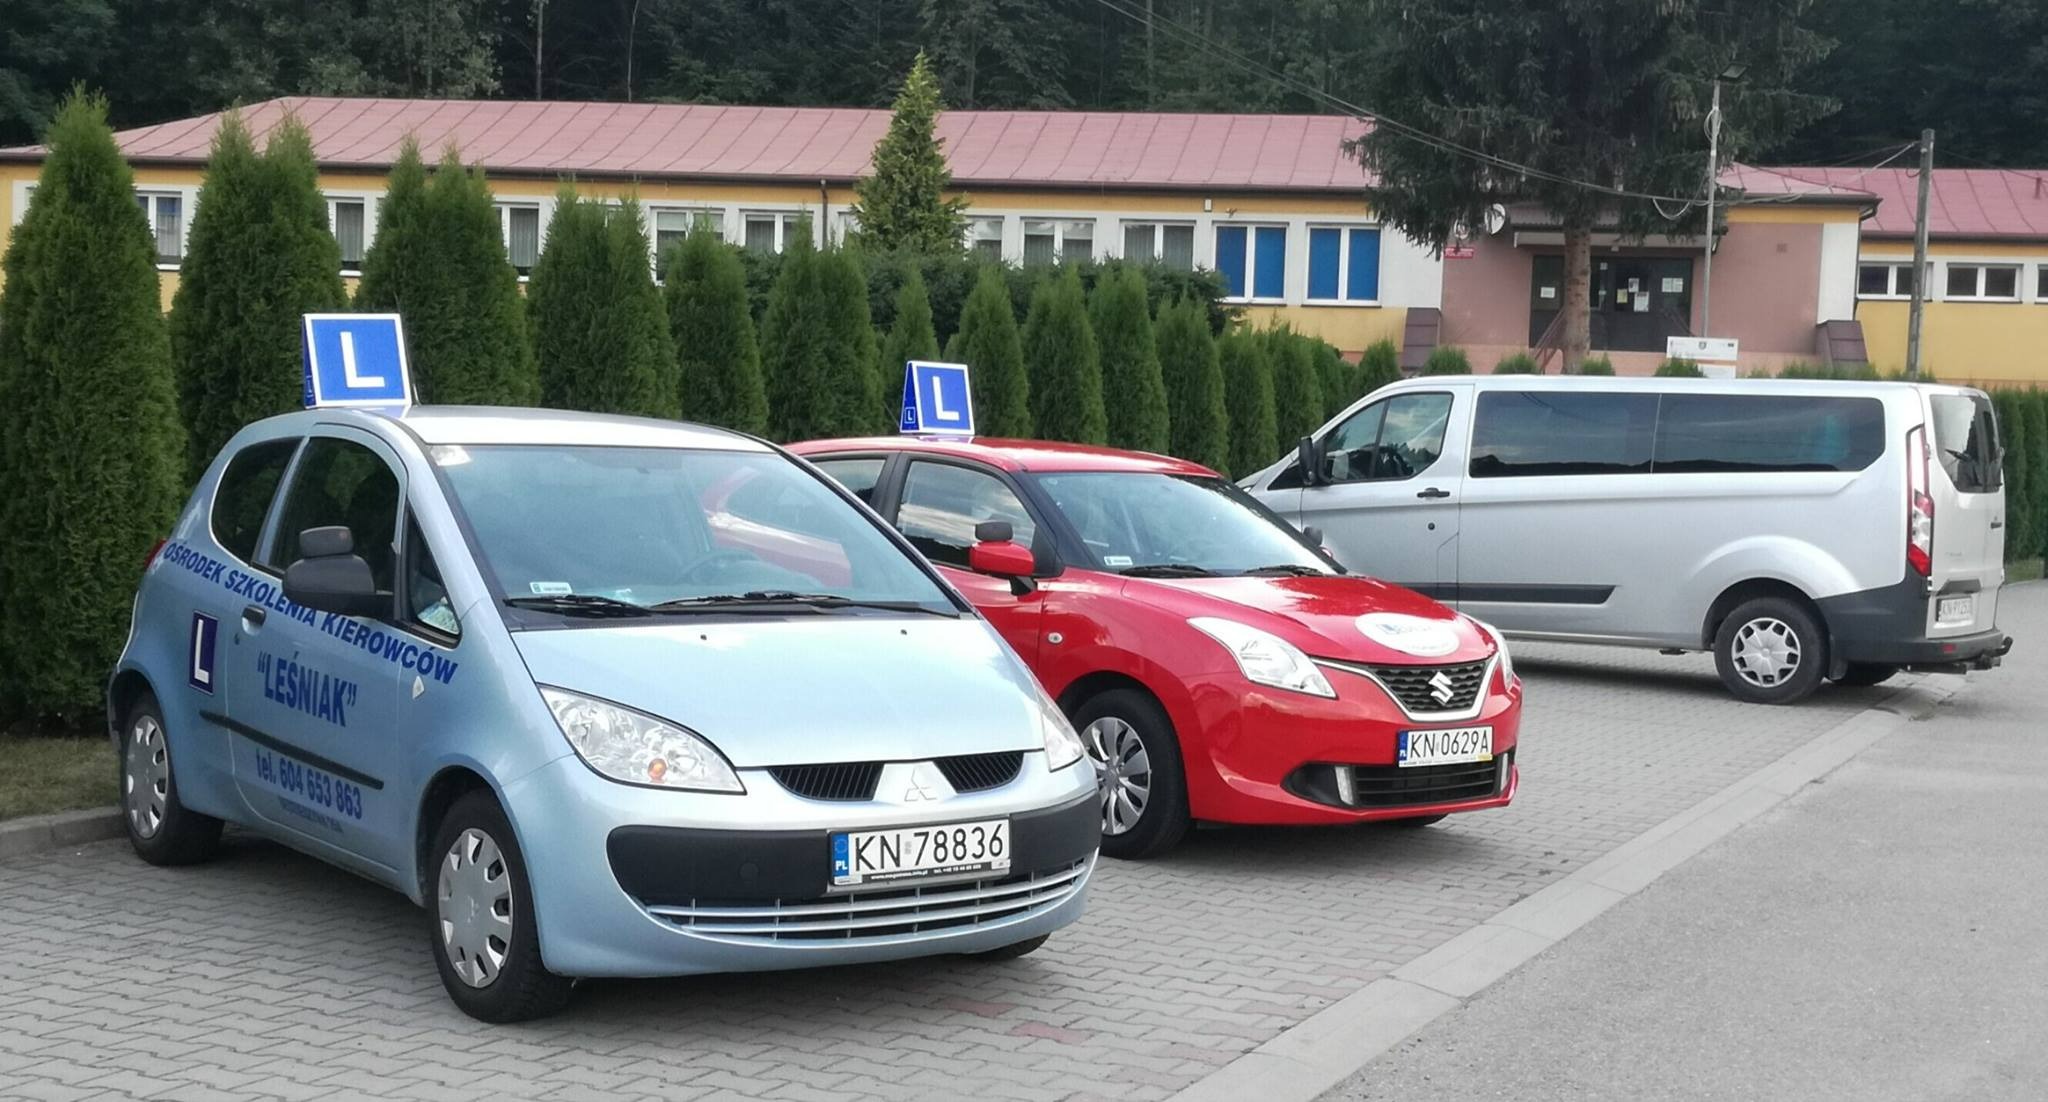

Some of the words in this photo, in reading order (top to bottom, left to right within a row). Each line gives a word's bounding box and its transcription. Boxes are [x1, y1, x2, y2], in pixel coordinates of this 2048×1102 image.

[340, 331, 385, 388] L
[932, 376, 960, 421] L
[163, 541, 226, 585] OŚRODEK
[224, 569, 316, 627] SZKOLENIA
[320, 612, 458, 685] KIEROWCÓW
[194, 619, 209, 684] L
[1410, 733, 1436, 759] KN
[1441, 729, 1489, 756] 0629A
[256, 749, 277, 785] tel.
[280, 758, 304, 796] 604
[306, 769, 331, 808] 653
[335, 780, 362, 820] 863
[835, 860, 848, 872] PL
[855, 834, 900, 872] KN
[913, 824, 1003, 866] 78836
